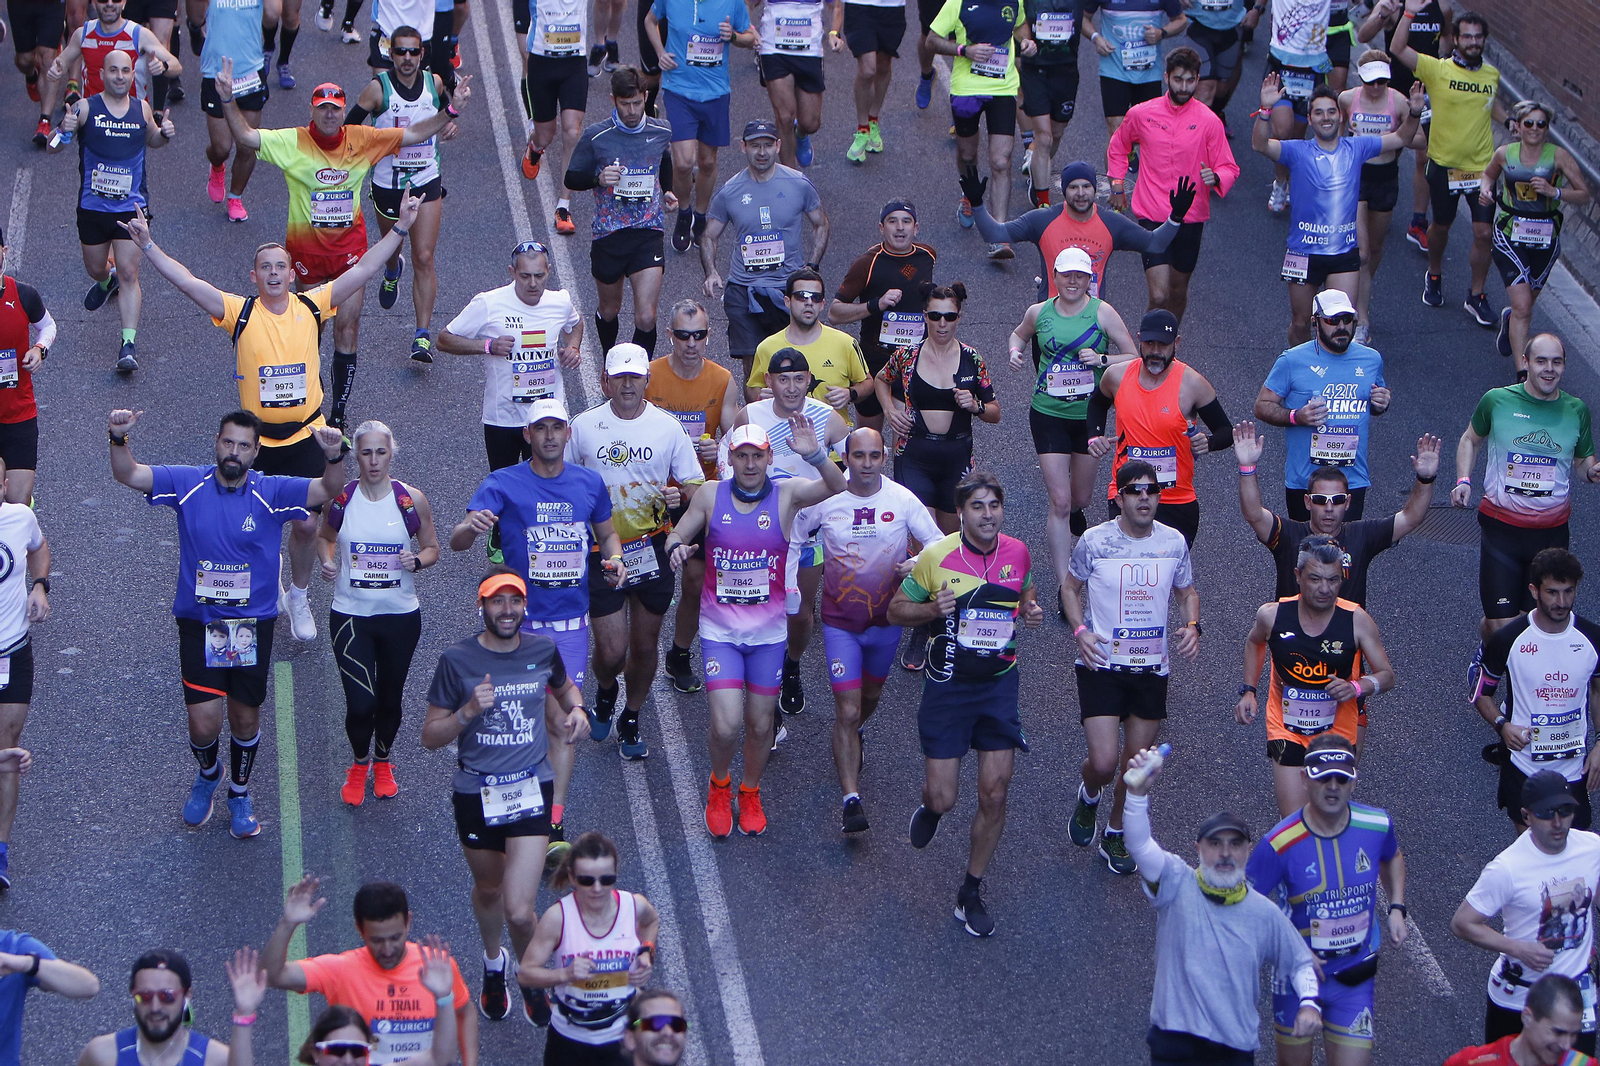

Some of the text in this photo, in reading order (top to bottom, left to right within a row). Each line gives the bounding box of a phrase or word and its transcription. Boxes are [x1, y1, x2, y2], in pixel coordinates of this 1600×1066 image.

[105, 165, 129, 175] ZURICH
[629, 166, 651, 174] ZURICH
[627, 180, 643, 188] 9957
[325, 192, 350, 200] ZURICH
[325, 206, 343, 214] 6494
[1298, 221, 1335, 234] CONTIGO
[753, 234, 778, 242] ZURICH
[1301, 234, 1329, 245] ESTOY
[755, 248, 771, 256] 8277
[898, 314, 923, 322] ZURICH
[895, 328, 914, 336] 6912
[506, 350, 554, 361] JACINTO
[274, 366, 300, 375] ZURICH
[528, 362, 551, 371] ZURICH
[1061, 363, 1087, 371] ZURICH
[274, 382, 294, 390] 9973
[340, 363, 355, 402] Kalenji
[528, 378, 545, 386] 6873
[1062, 378, 1081, 386] 8379
[1322, 383, 1359, 399] 42K
[275, 392, 294, 400] SIMON
[1327, 426, 1354, 435] ZURICH
[1326, 441, 1345, 449] 6897
[1142, 449, 1171, 457] ZURICH
[1523, 457, 1551, 465] ZURICH
[1522, 471, 1541, 479] 7718
[367, 545, 398, 553] ZURICH
[547, 543, 576, 551] ZURICH
[213, 563, 245, 571] ZURICH
[367, 561, 388, 569] 8452
[546, 560, 567, 568] 8100
[731, 561, 761, 571] ZURICH
[212, 579, 234, 588] 8065
[732, 578, 753, 586] 7842
[215, 590, 229, 598] FITO
[724, 588, 742, 596] DAVID
[747, 588, 761, 596] ANA
[976, 628, 997, 637] 7357
[1130, 629, 1160, 638] ZURICH
[971, 639, 997, 647] ENRIQUE
[1128, 646, 1149, 655] 6862
[1520, 642, 1538, 655] edp
[1129, 656, 1146, 665] IÑIGO
[1292, 660, 1328, 677] aodi
[1544, 670, 1569, 683] edp
[516, 681, 539, 691] SPRINT
[501, 700, 524, 712] SAL
[1298, 708, 1321, 717] 7112
[1297, 719, 1320, 727] MIGUEL
[476, 730, 534, 745] TRIATLÓN
[1550, 732, 1570, 741] 8896
[501, 789, 523, 801] 9536
[1325, 889, 1339, 900] TRI
[1340, 881, 1373, 898] SPORTS
[1331, 903, 1363, 918] ZURICH
[1331, 925, 1355, 937] 8059
[1328, 936, 1356, 947] MANUEL
[584, 979, 610, 989] 6072
[390, 999, 421, 1011] TRAIL
[392, 1020, 430, 1032] ZURICH
[389, 1041, 421, 1053] 10523
